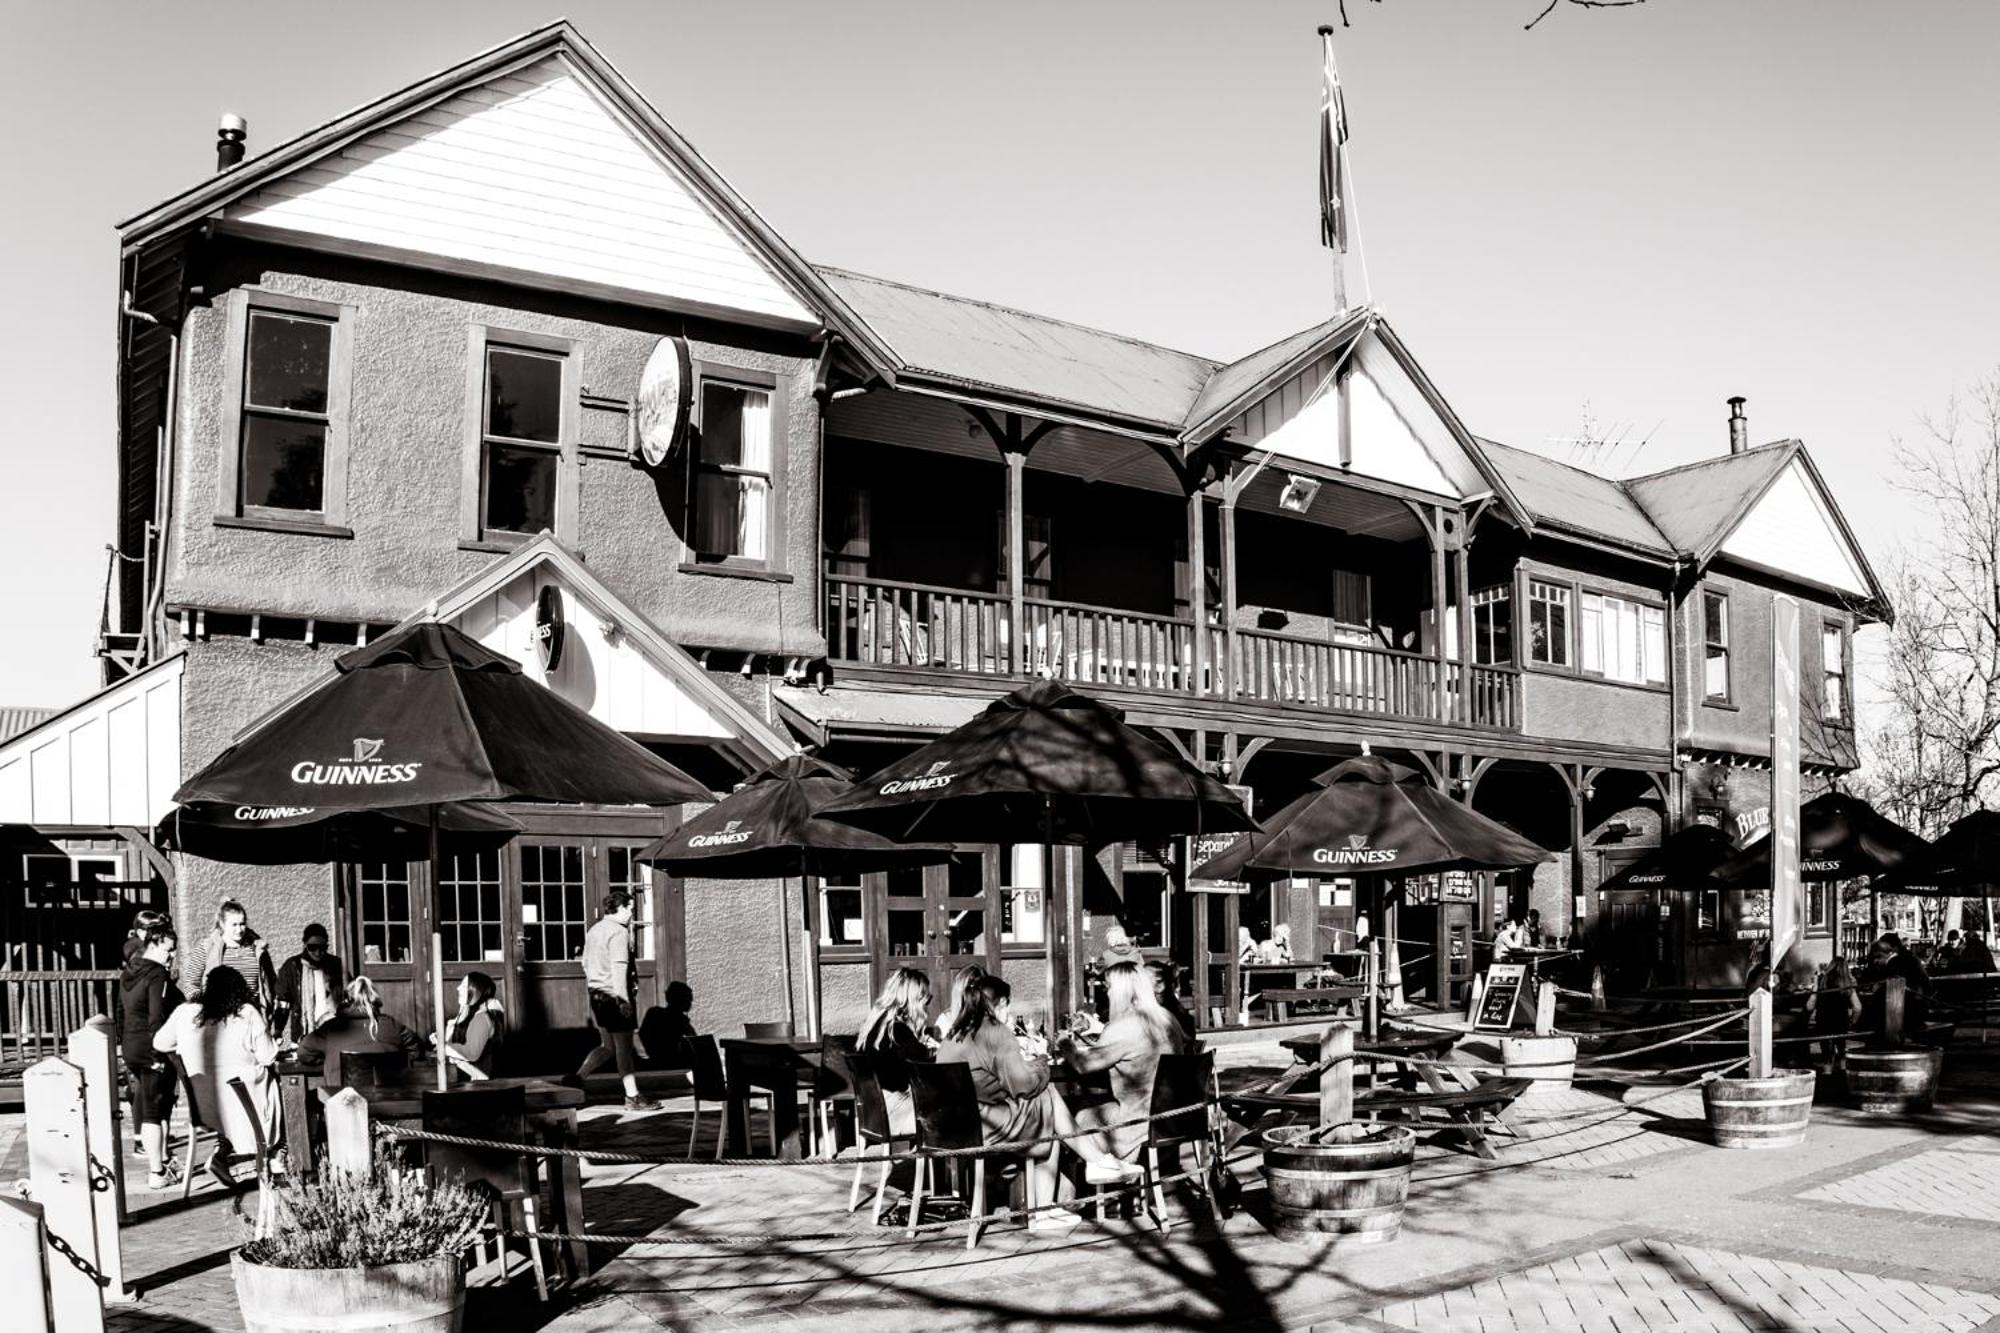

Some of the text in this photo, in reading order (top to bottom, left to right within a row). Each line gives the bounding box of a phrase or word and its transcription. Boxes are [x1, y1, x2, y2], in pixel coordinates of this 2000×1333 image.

[291, 761, 418, 784] GUINNESS
[880, 775, 953, 795] GUINNESS
[688, 832, 750, 848] GUINNESS
[1313, 848, 1396, 864] GUINNESS
